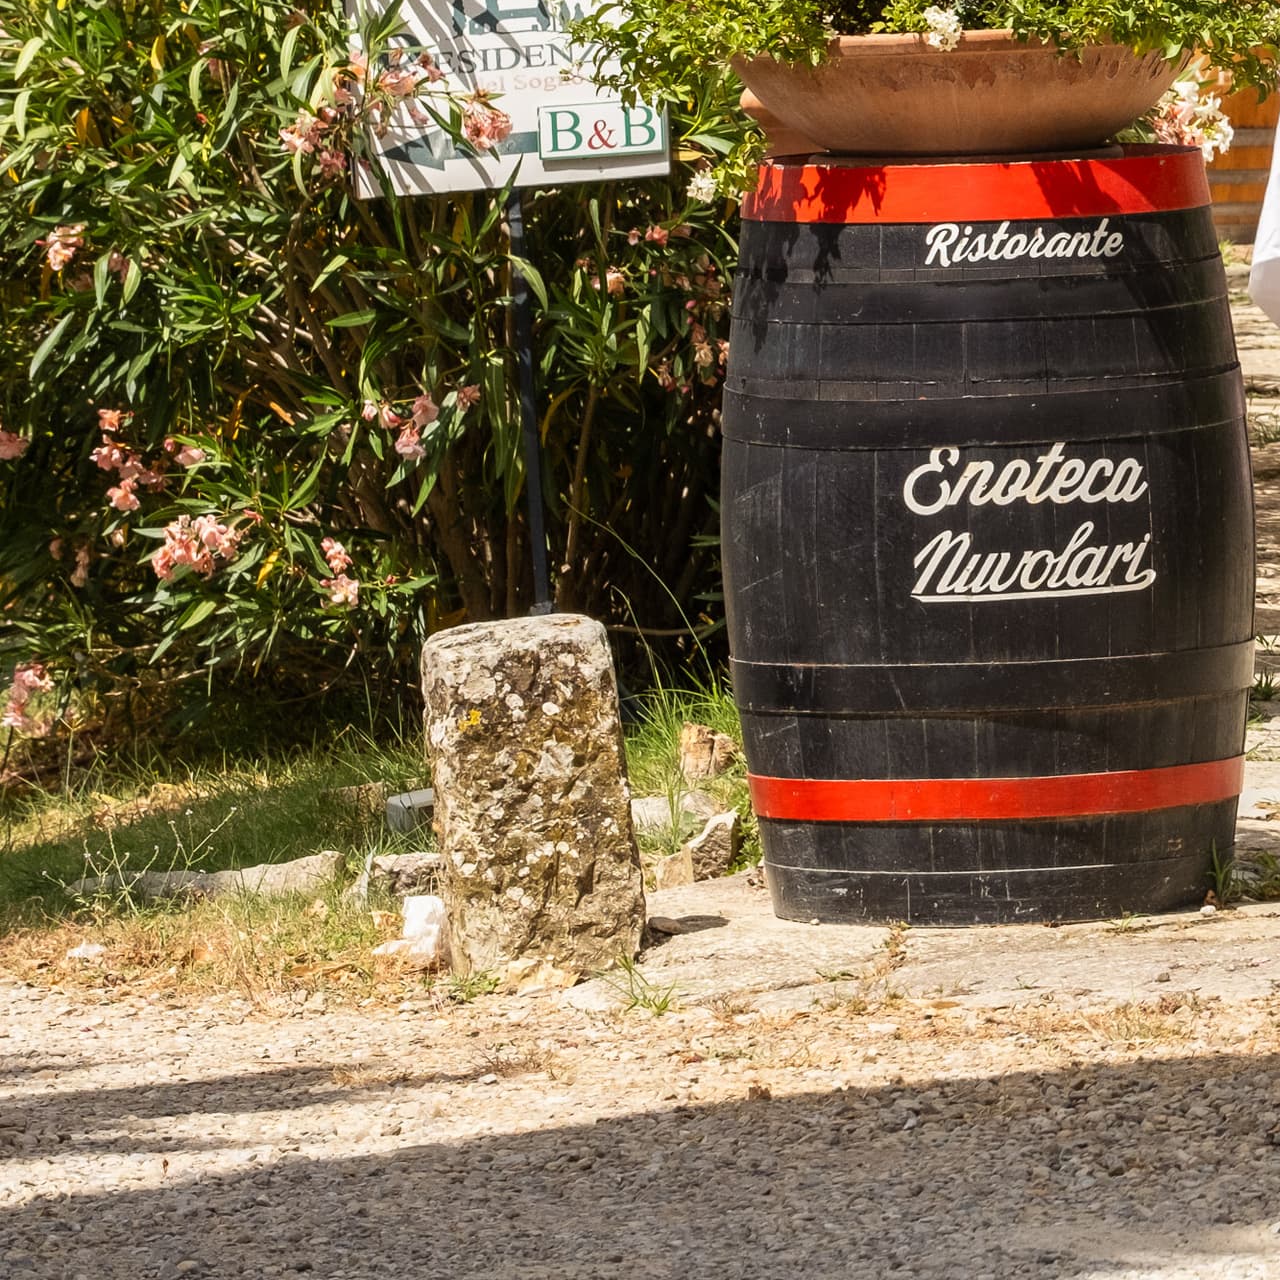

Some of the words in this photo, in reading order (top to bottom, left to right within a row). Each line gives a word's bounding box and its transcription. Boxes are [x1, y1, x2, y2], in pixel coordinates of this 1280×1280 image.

[379, 33, 621, 75] RESIDENZ
[549, 105, 657, 153] B&B
[925, 218, 1124, 268] Ristorante
[903, 442, 1150, 517] Enoteca
[910, 521, 1157, 603] Nuvolari
